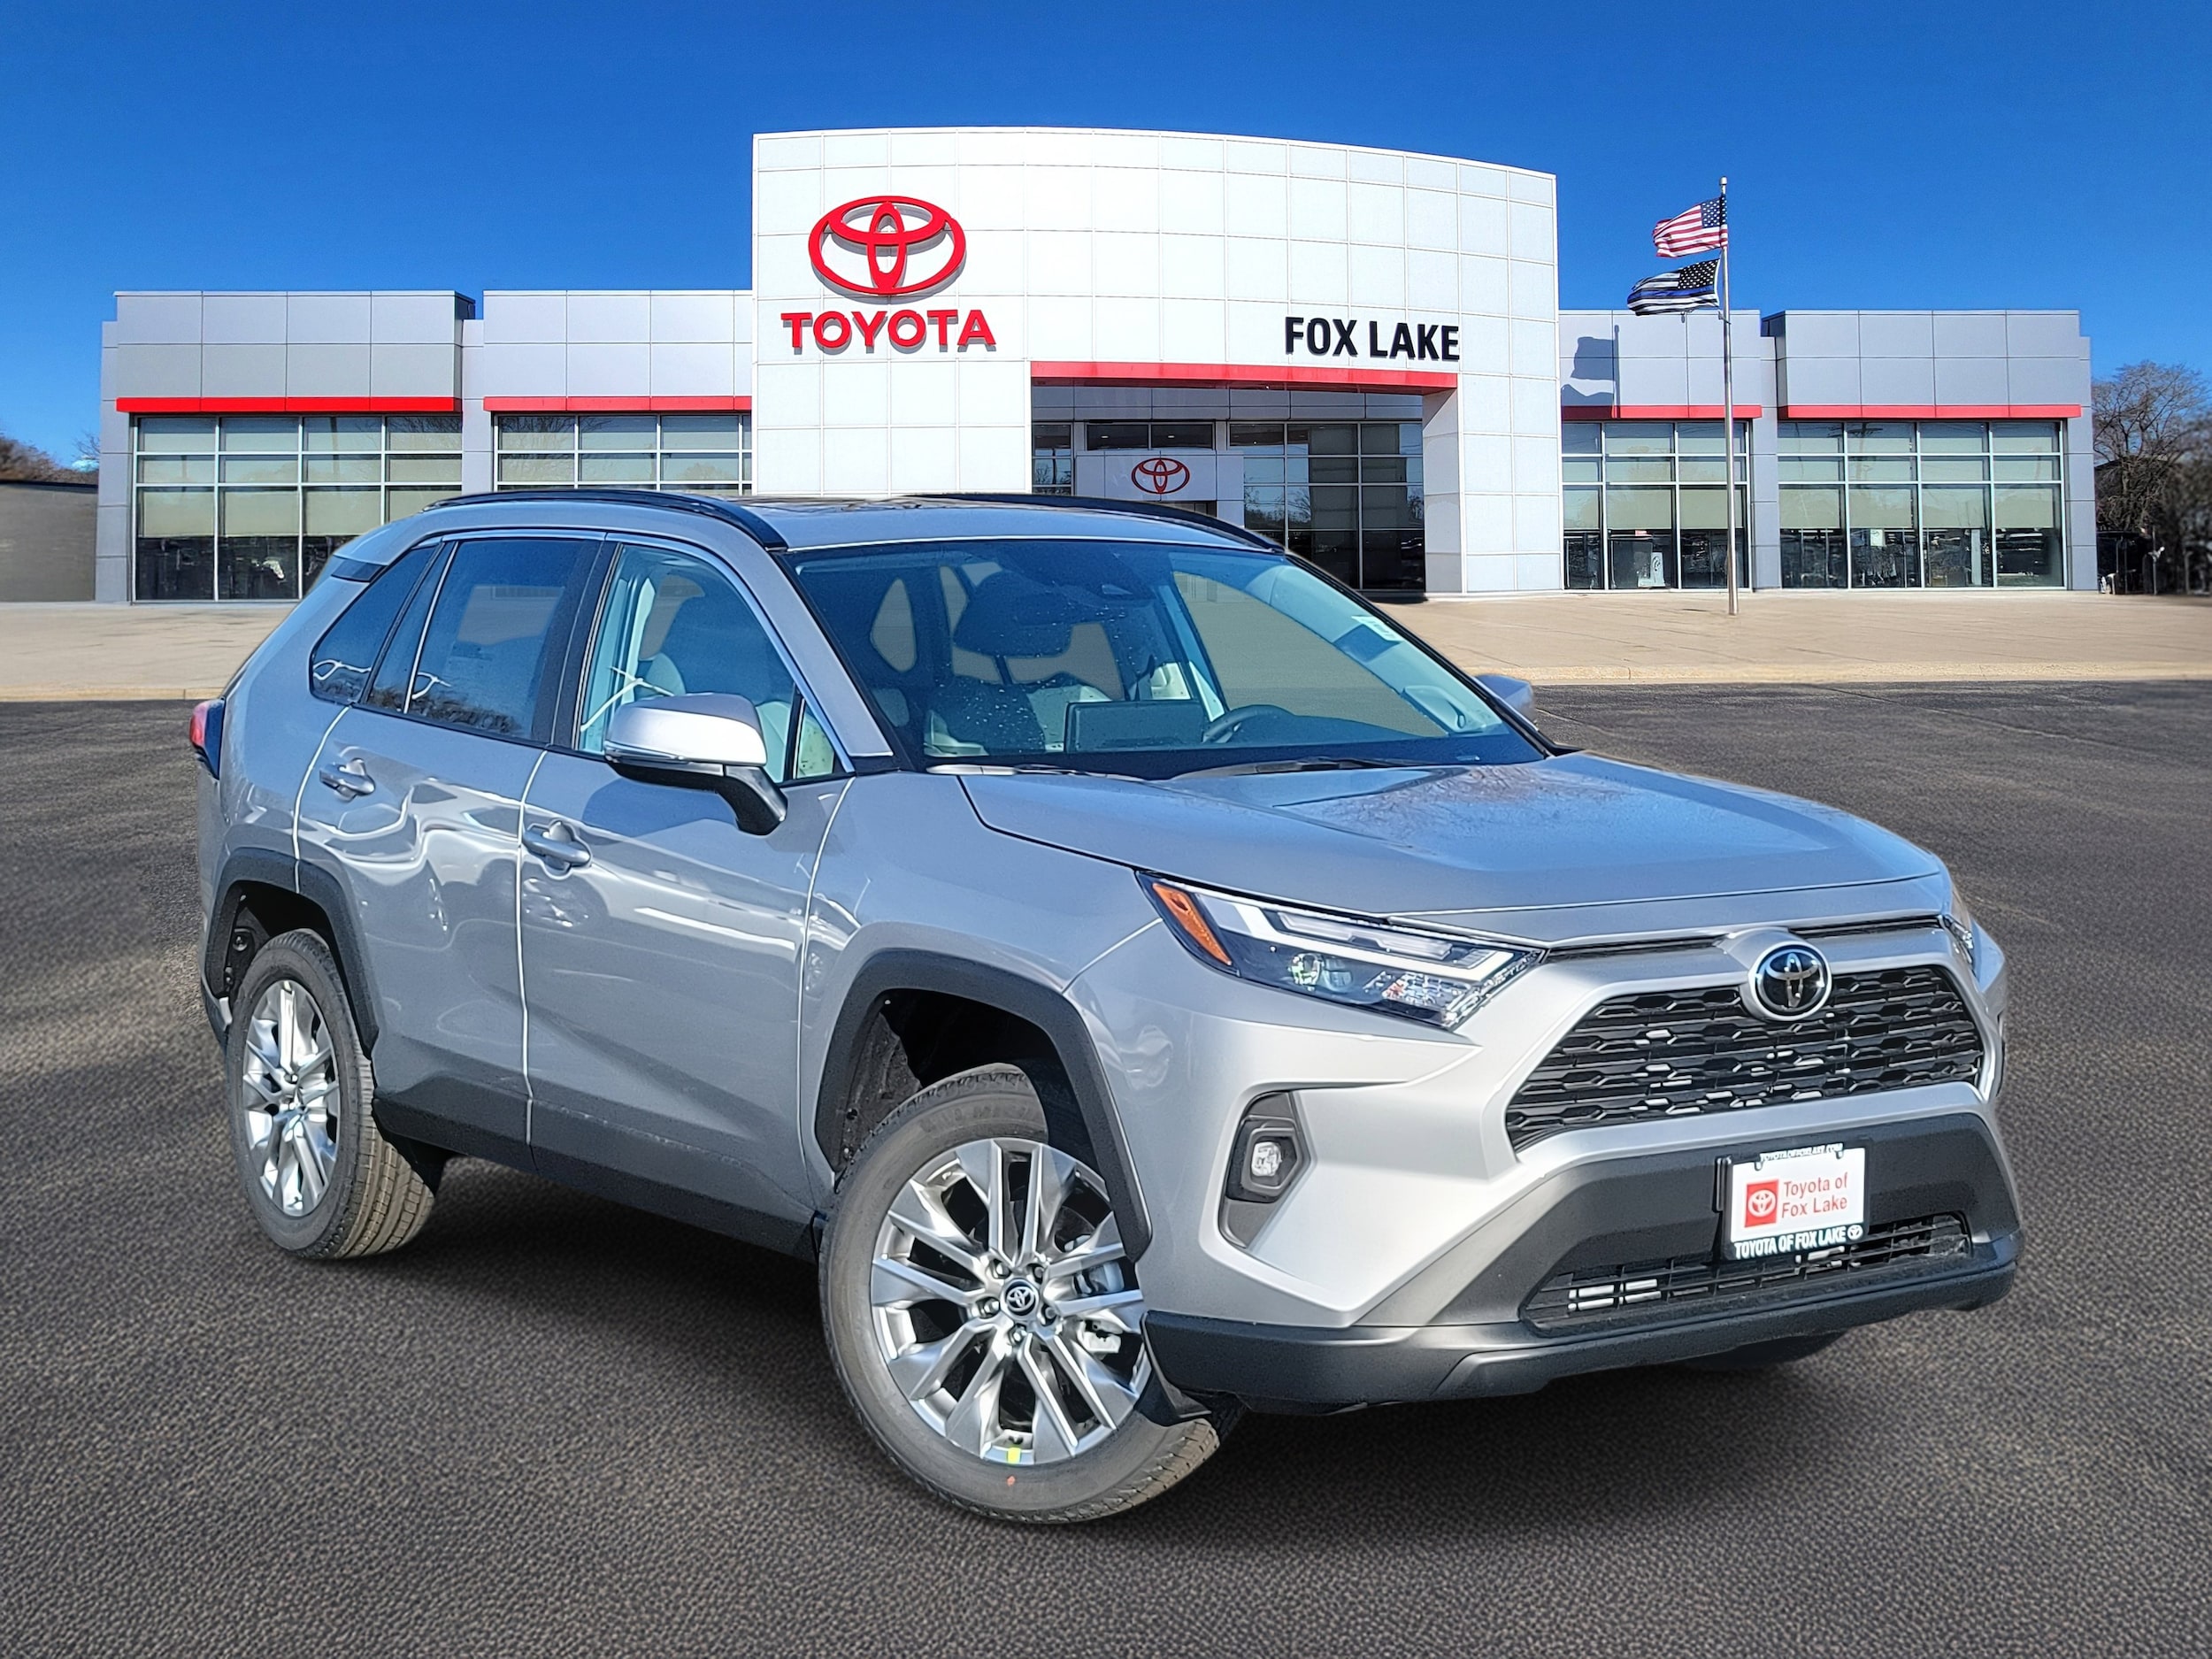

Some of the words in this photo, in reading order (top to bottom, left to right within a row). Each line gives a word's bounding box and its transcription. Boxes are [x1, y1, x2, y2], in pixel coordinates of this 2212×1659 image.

[780, 309, 997, 351] TOYOTA
[1285, 317, 1358, 357] FOX
[1369, 321, 1460, 361] LAKE
[1784, 1177, 1830, 1199] Toyota
[1835, 1171, 1848, 1189] of
[1782, 1202, 1808, 1218] Fox
[1813, 1194, 1847, 1214] Lake
[1734, 1237, 1778, 1260] TOYOTA
[1778, 1234, 1794, 1253] OF
[1794, 1230, 1818, 1250] FOX
[1818, 1225, 1847, 1247] LAKE
